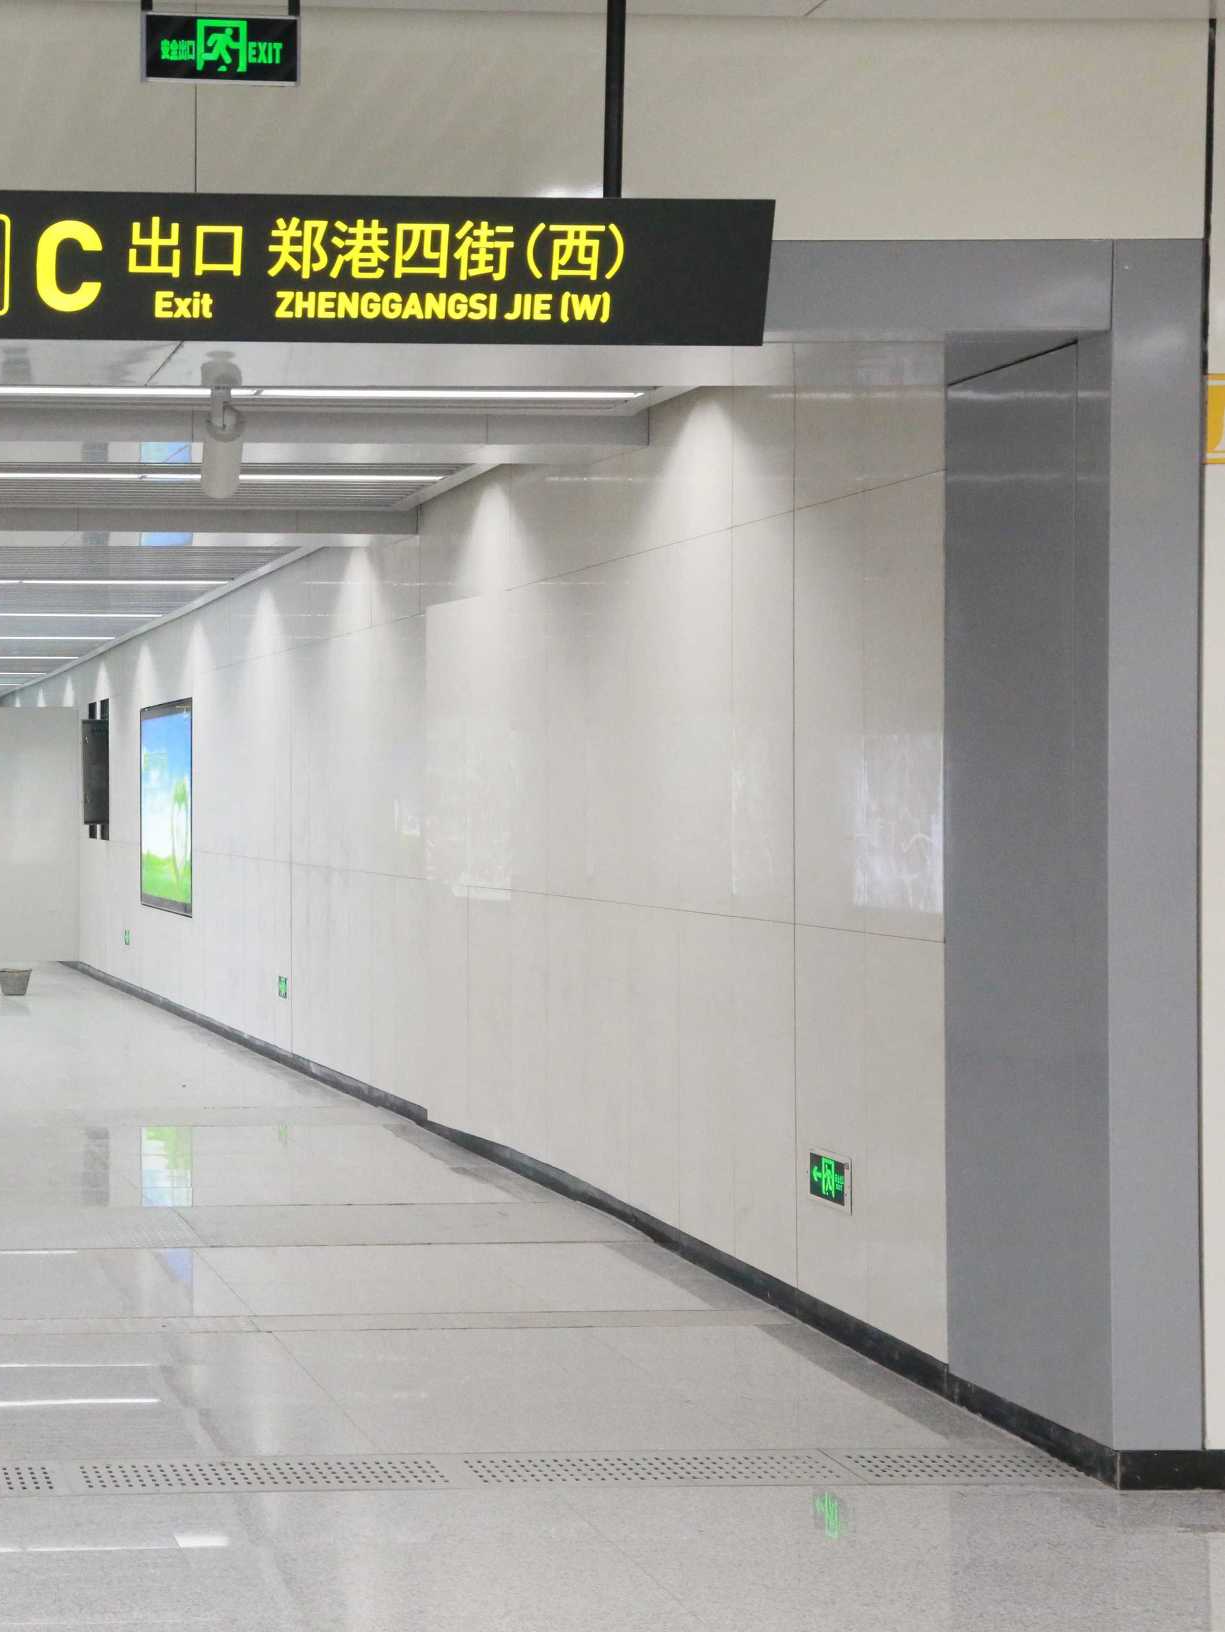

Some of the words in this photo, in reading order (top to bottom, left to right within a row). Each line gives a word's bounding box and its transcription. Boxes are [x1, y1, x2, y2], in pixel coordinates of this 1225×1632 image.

[248, 41, 283, 64] EXIT
[35, 219, 104, 313] C
[126, 214, 245, 279] 出口
[152, 288, 215, 321] Exit
[274, 289, 499, 321] ZHENGGANGSI
[504, 291, 554, 321] JIE
[559, 290, 613, 325] (W)
